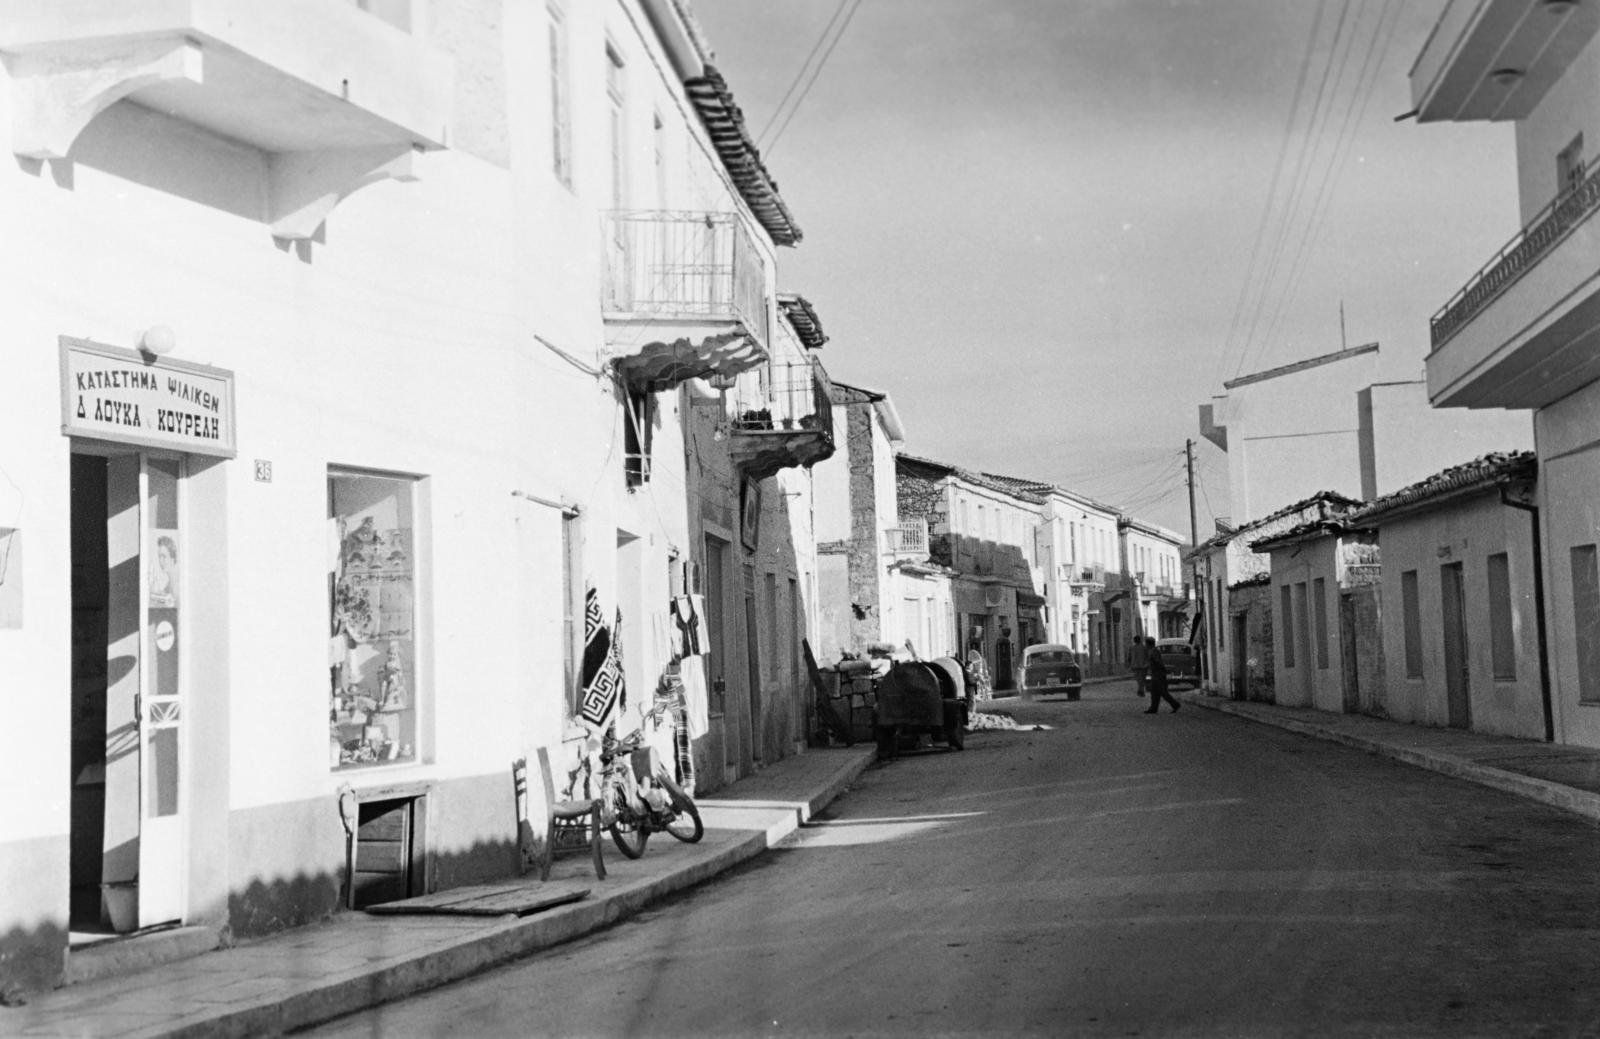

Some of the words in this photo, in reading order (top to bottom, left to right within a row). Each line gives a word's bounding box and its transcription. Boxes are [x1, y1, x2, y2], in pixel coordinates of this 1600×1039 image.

[76, 370, 158, 391] ΚΑΤΑΣΤΗΜΑ
[167, 376, 219, 413] ΨΙΛΙΚΩΝ
[94, 398, 141, 427] ΛΟΥΚΑ
[158, 408, 219, 439] ΚΟΥΡΕΛΗ
